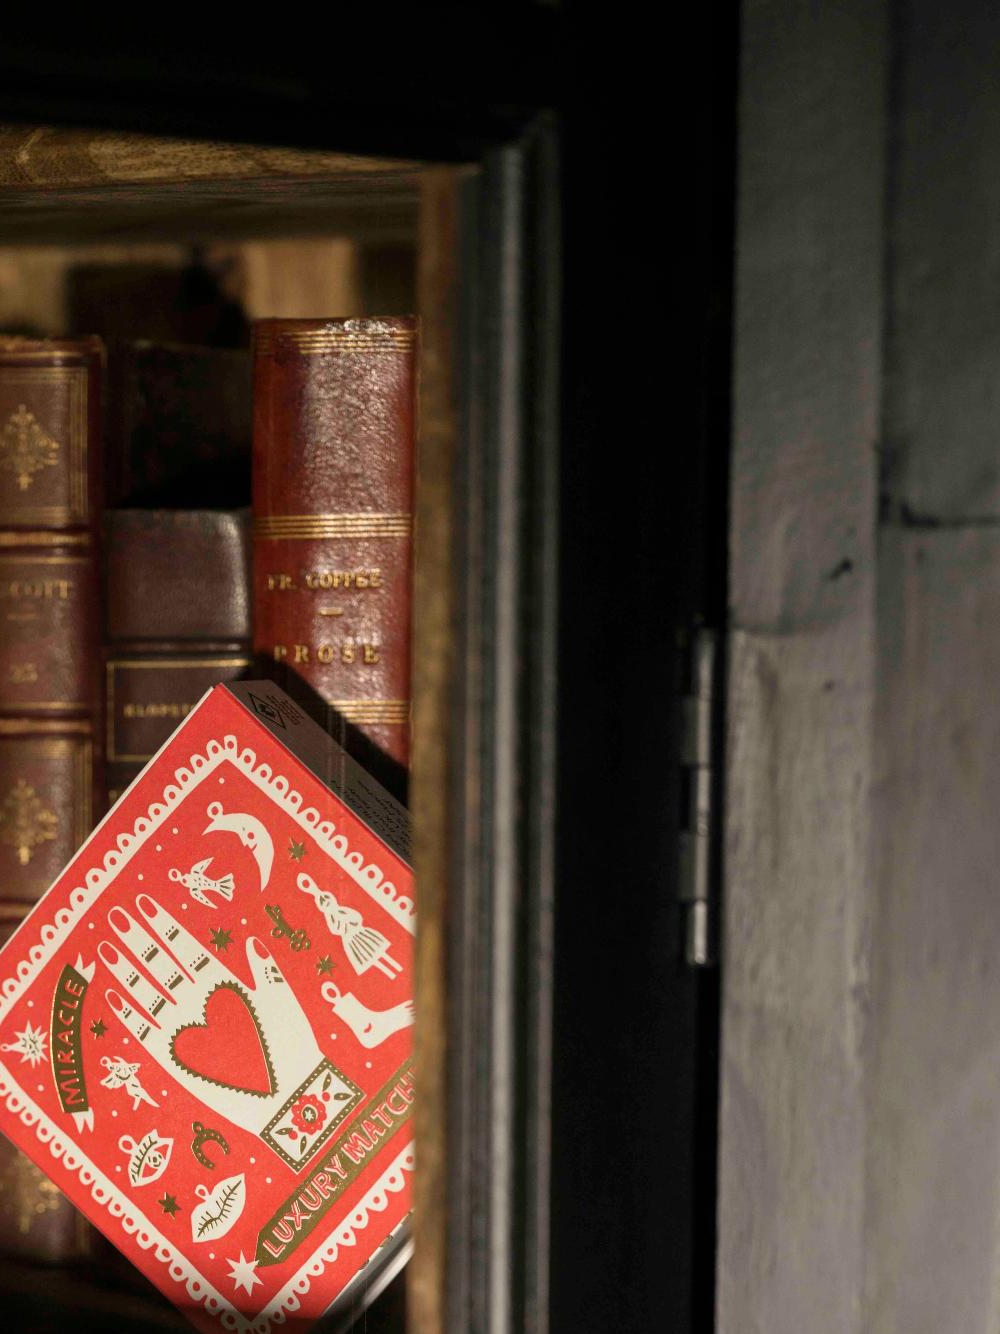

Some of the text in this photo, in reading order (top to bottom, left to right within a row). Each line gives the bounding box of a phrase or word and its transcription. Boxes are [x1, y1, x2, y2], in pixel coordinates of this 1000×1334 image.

[274, 643, 380, 664] PROSE
[56, 979, 85, 1106] MIRACLE
[262, 1153, 348, 1258] LUXURY
